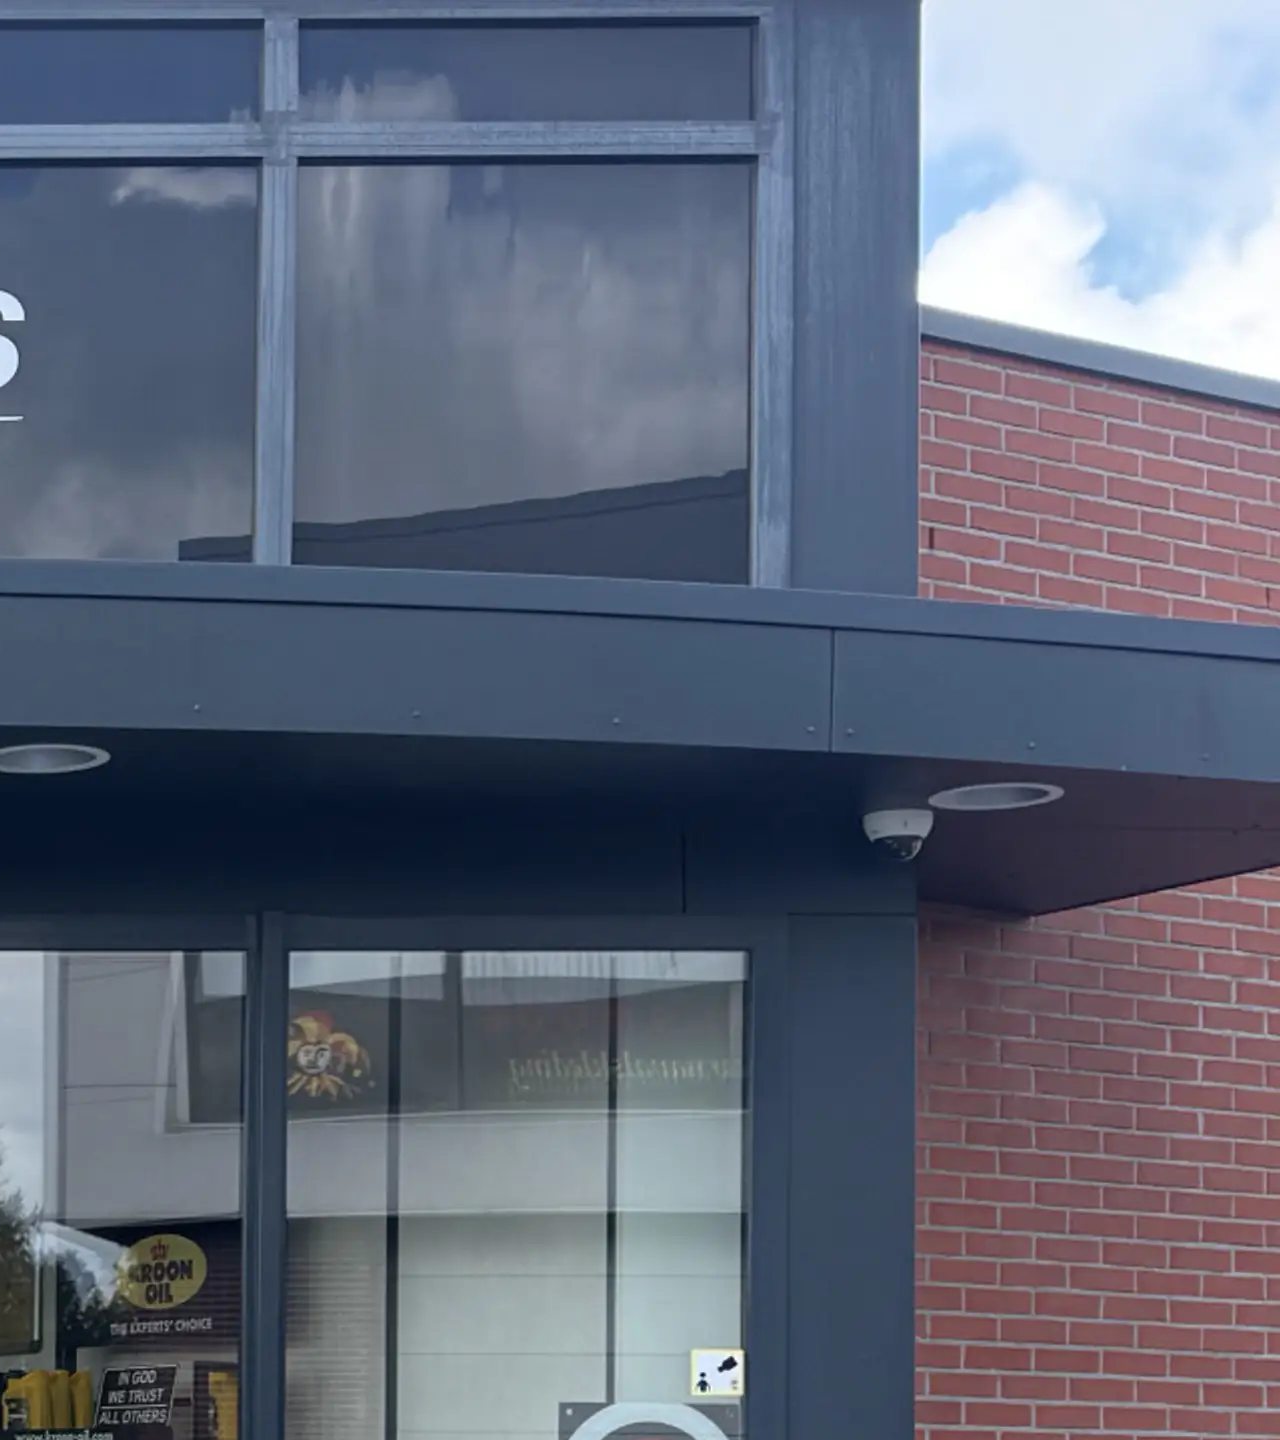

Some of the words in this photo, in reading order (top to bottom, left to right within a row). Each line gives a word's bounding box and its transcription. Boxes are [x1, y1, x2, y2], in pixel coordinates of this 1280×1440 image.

[128, 1260, 193, 1282] KROON
[145, 1283, 174, 1304] OIL
[118, 1372, 129, 1386] IN
[132, 1370, 157, 1384] GOD
[108, 1390, 125, 1404] WE
[128, 1388, 165, 1403] TRUST
[98, 1411, 120, 1424] ALL
[122, 1408, 168, 1424] OTHERS
